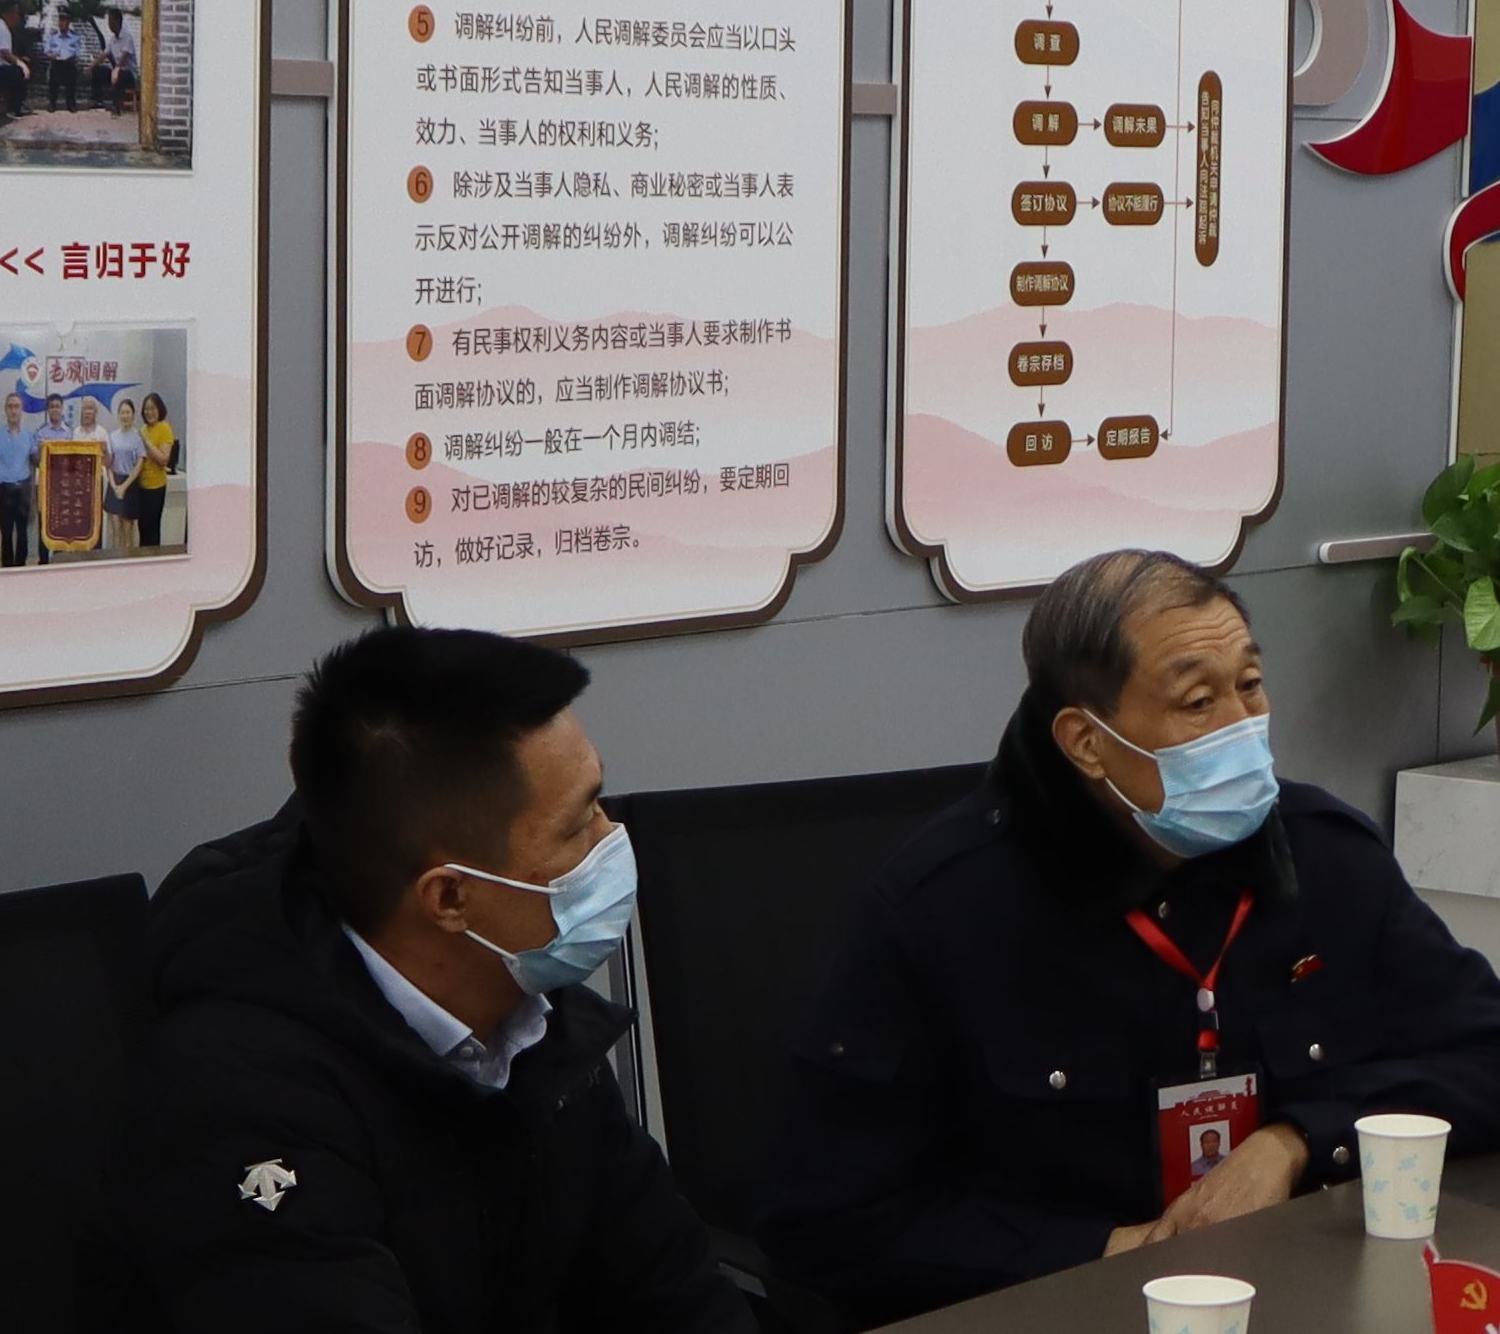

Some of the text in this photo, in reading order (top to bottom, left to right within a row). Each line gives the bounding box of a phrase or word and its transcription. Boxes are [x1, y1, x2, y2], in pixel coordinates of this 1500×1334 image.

[1035, 33, 1061, 52] 调查
[1033, 112, 1059, 132] 调解
[1113, 115, 1157, 135] 调解未果
[1020, 193, 1067, 213] 签订协议
[1109, 193, 1158, 213] 协议不能履行
[61, 243, 191, 280] 言归于好
[1016, 274, 1068, 293] 制作调解协议
[1017, 354, 1064, 373] 卷宗存档
[1025, 434, 1053, 452] 回访
[1106, 428, 1151, 447] 定期报告
